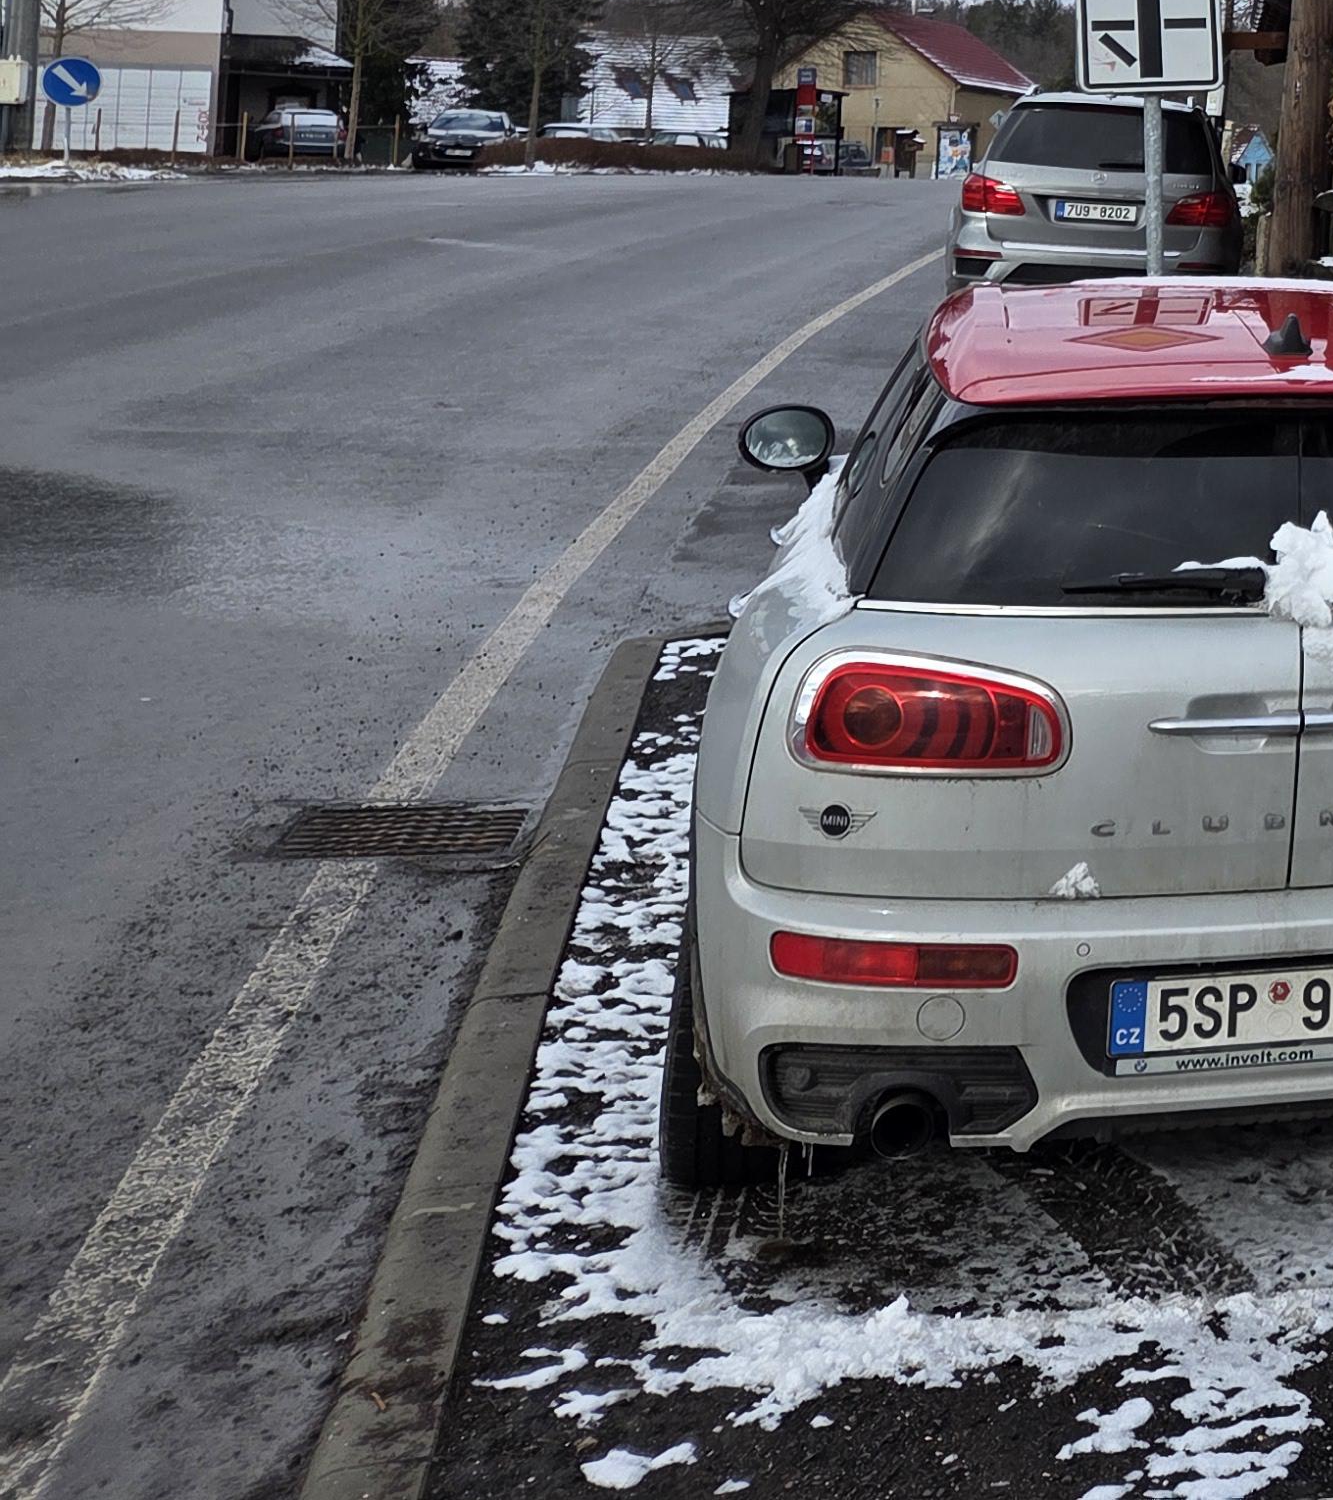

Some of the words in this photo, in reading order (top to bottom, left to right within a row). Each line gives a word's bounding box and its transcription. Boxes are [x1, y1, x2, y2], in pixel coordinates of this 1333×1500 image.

[1067, 204, 1090, 217] 7U9
[1099, 206, 1131, 219] 8202
[822, 815, 848, 827] MINI
[1158, 983, 1258, 1043] 5SP
[1115, 1028, 1141, 1046] CZ
